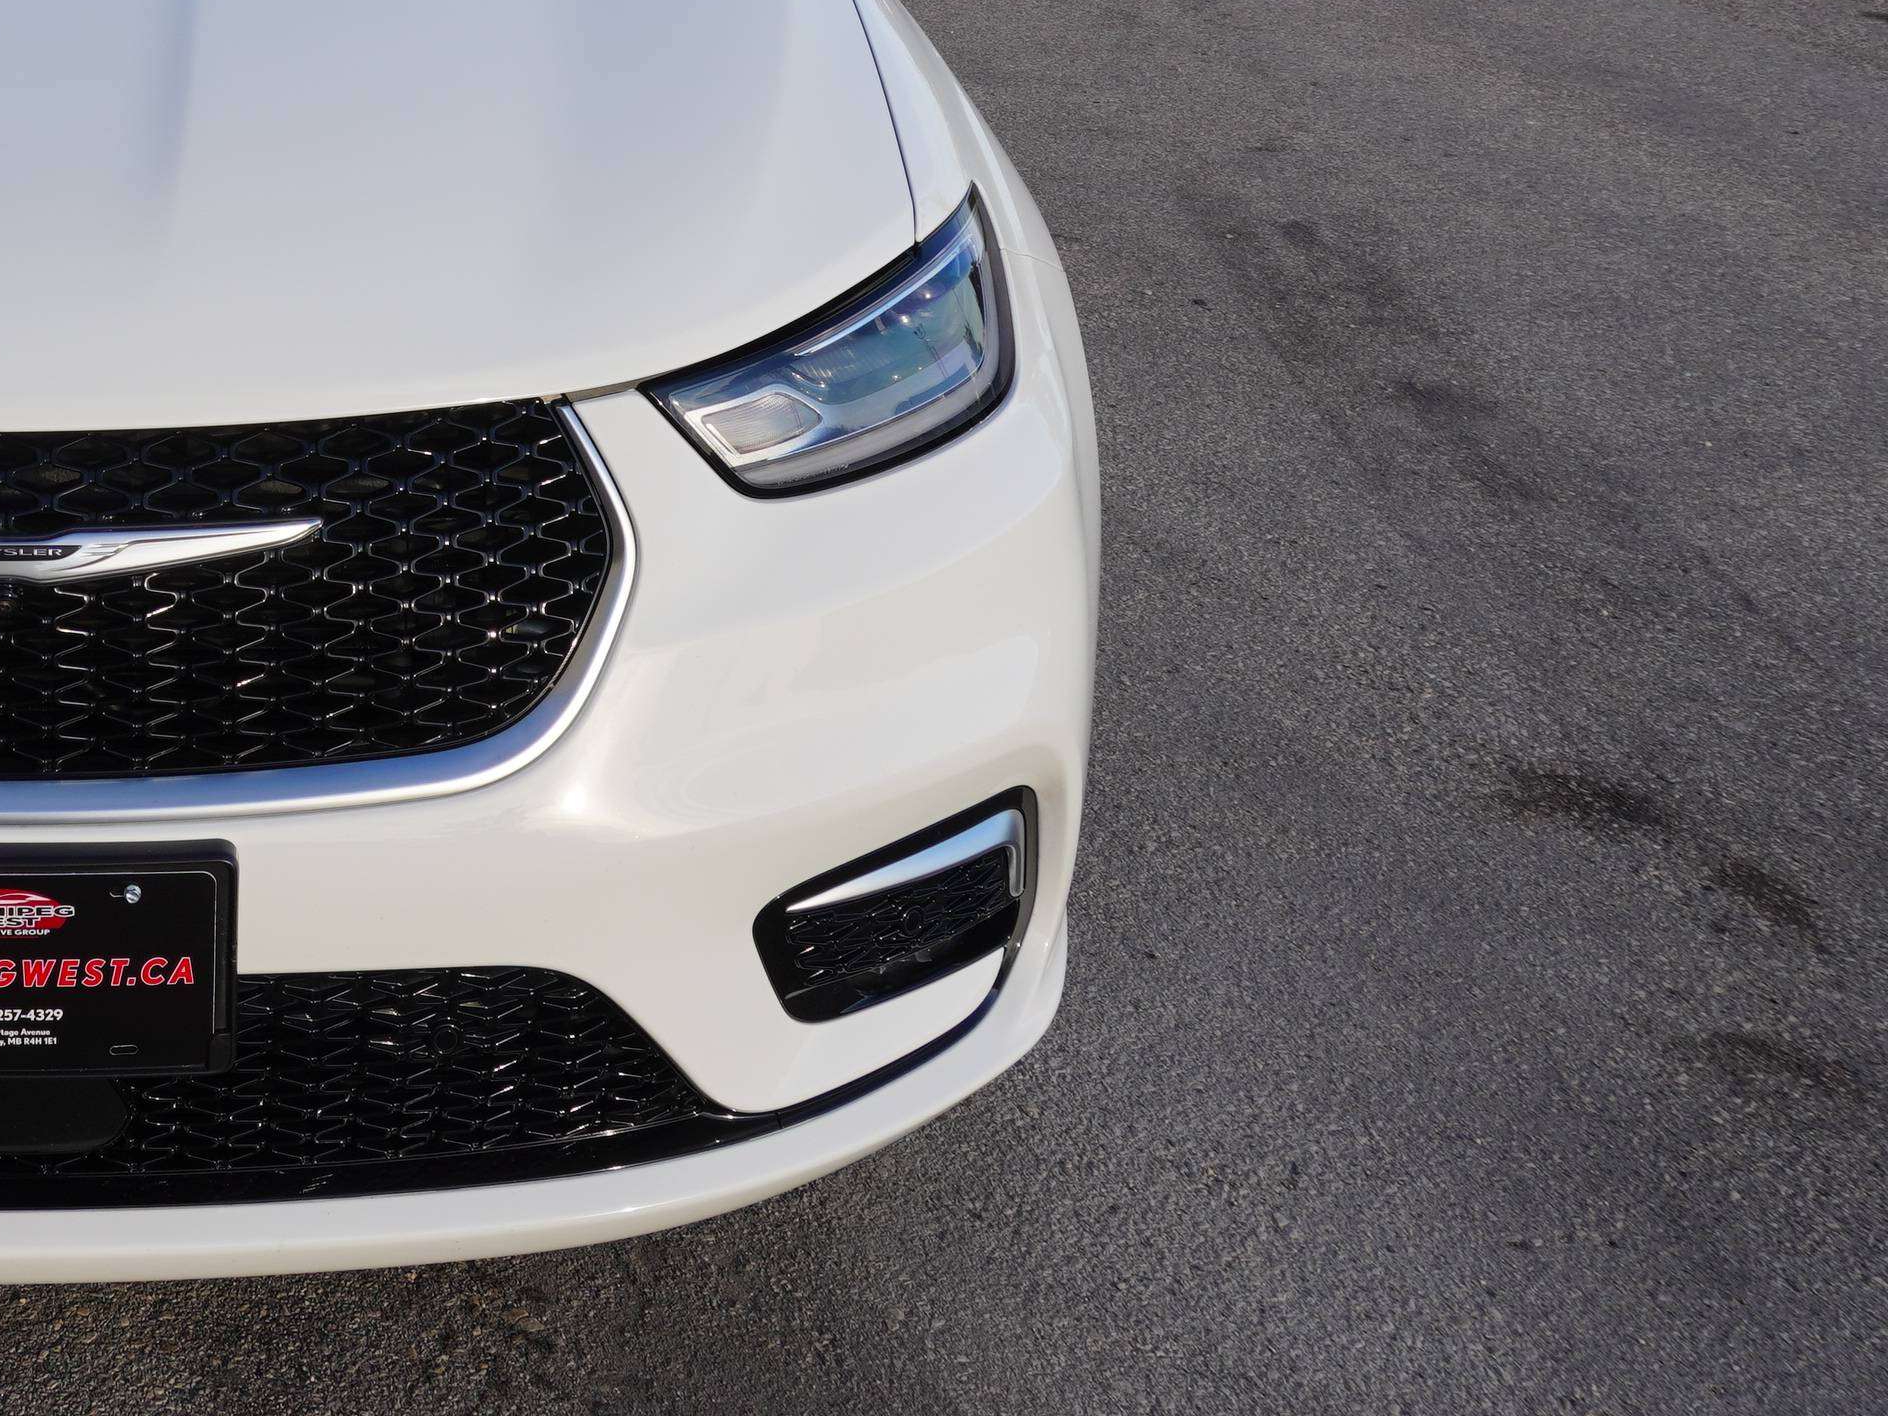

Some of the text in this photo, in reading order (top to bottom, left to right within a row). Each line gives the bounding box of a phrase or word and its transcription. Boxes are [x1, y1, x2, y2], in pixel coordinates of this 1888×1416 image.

[20, 1028, 51, 1036] Avenue
[7, 1037, 22, 1045] MB
[23, 1037, 42, 1045] R4H
[43, 1037, 57, 1045] 1E1
